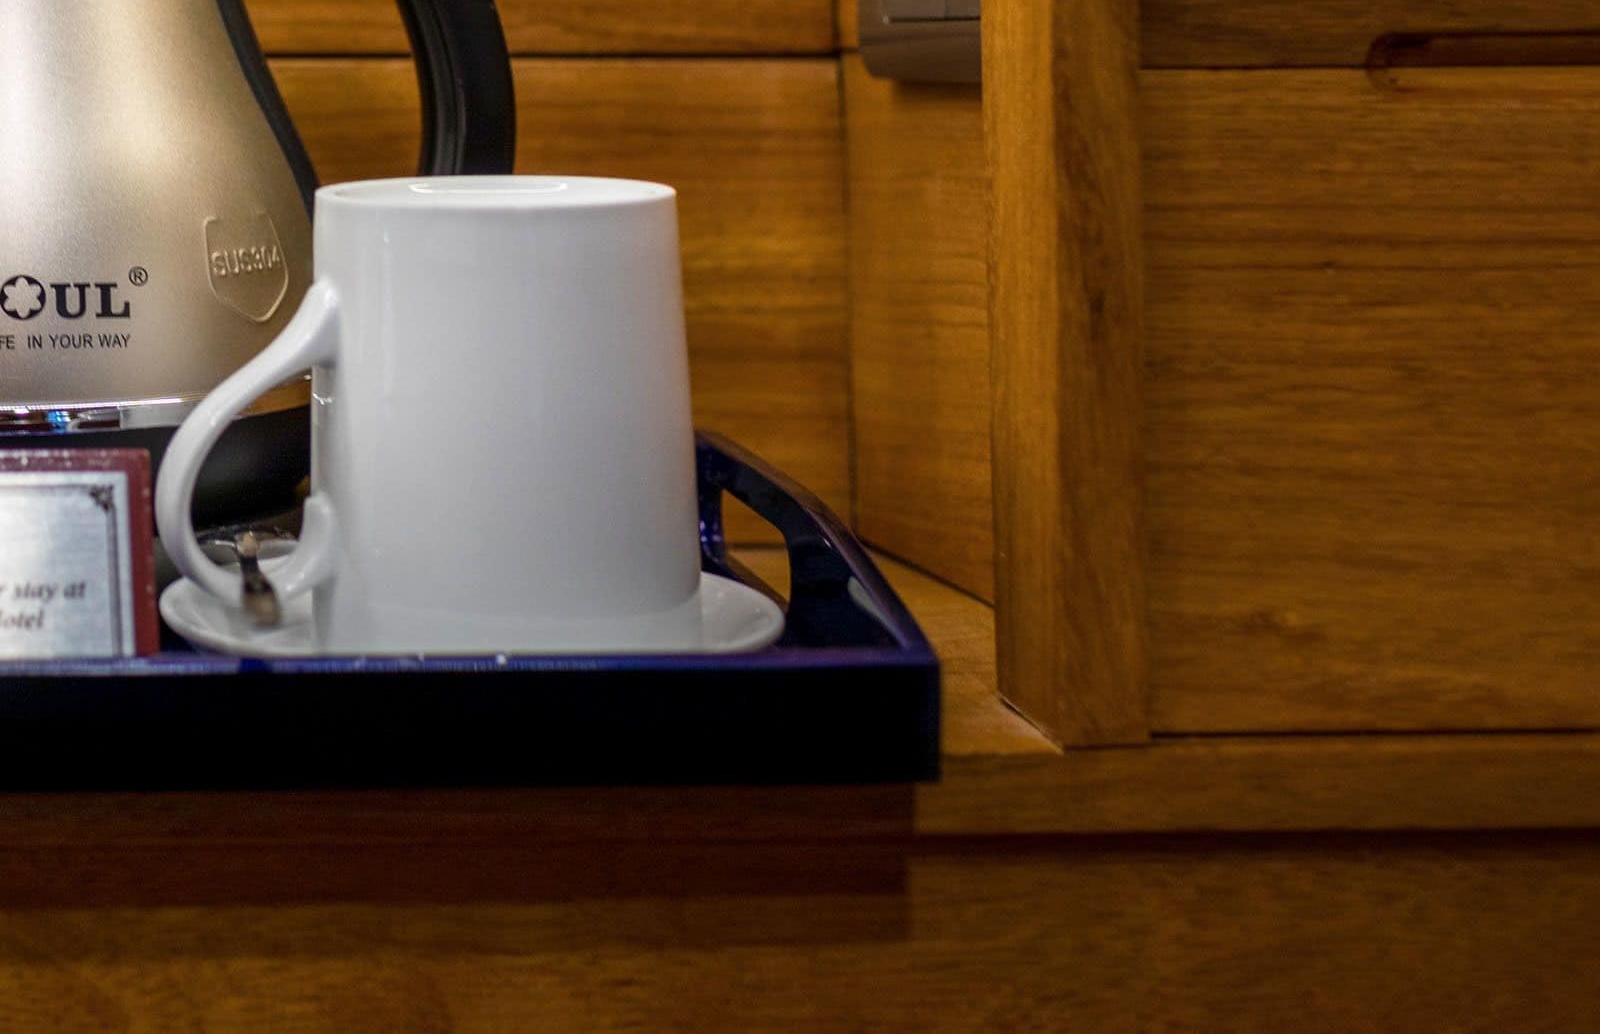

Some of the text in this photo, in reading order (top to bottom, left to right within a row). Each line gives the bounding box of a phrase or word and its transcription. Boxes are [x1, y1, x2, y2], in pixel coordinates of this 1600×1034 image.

[26, 333, 43, 350] IN
[48, 333, 94, 349] YOUR
[98, 333, 131, 348] WAY
[12, 581, 59, 605] stay
[63, 580, 88, 600] at
